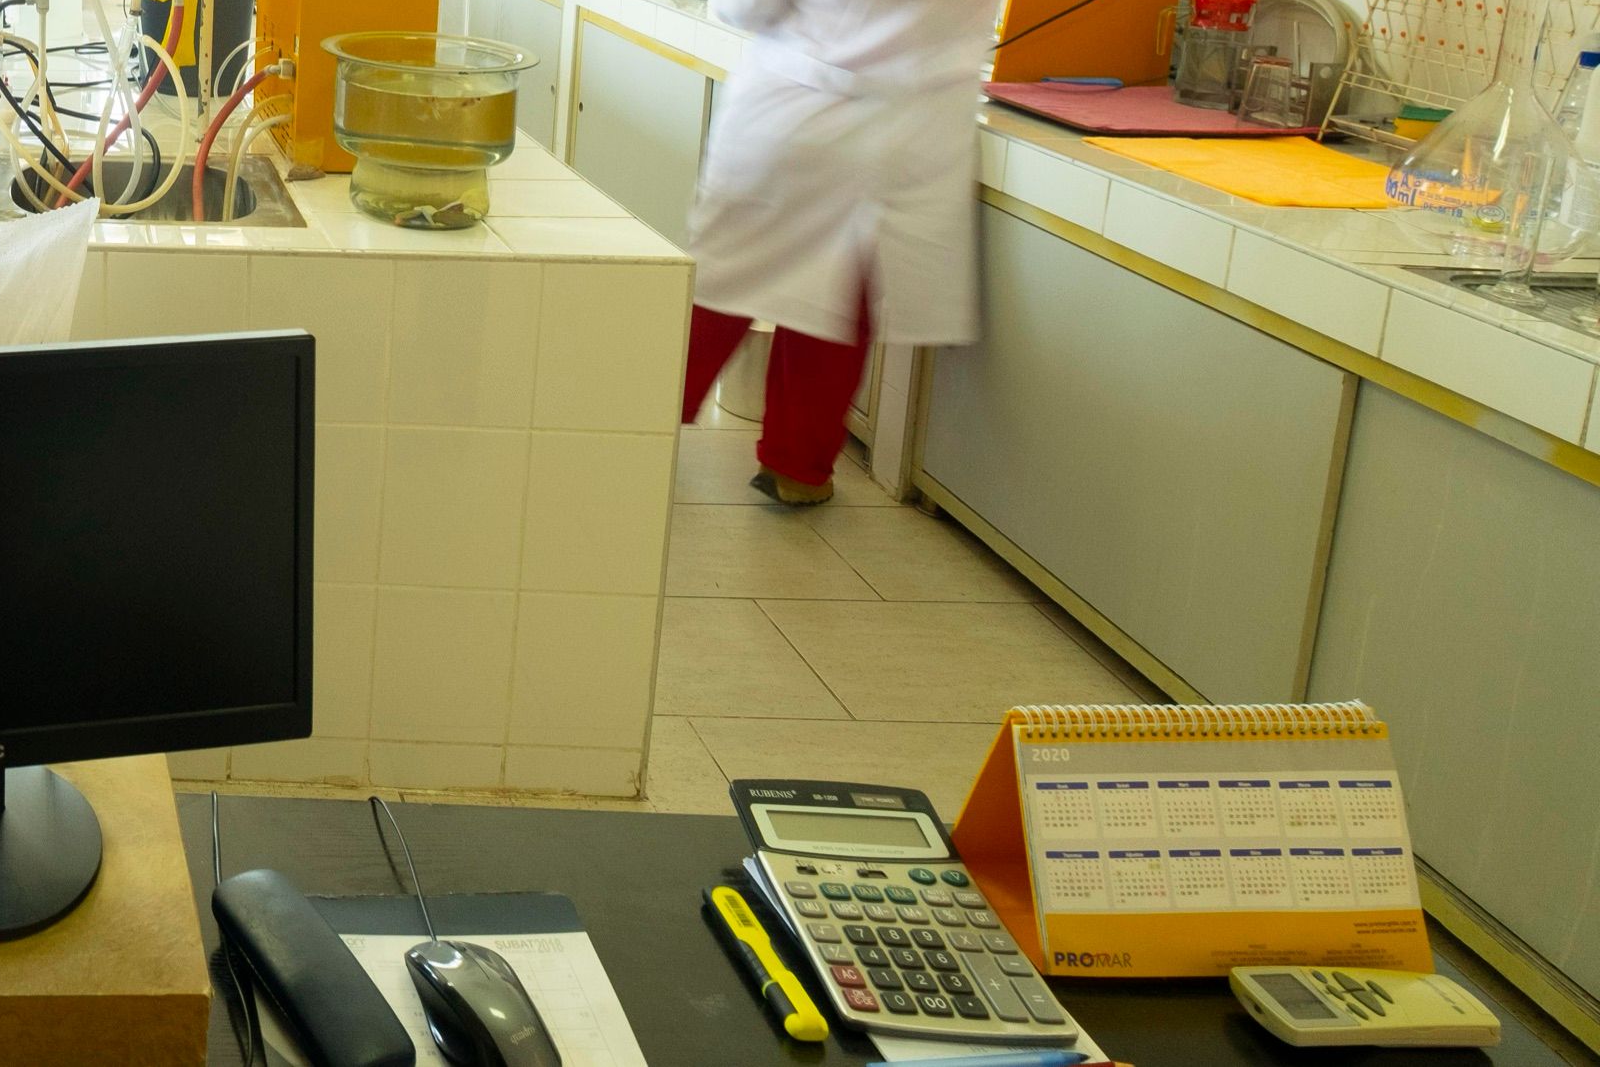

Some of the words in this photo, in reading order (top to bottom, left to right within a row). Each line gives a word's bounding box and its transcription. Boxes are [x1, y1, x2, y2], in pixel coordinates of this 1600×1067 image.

[1031, 748, 1070, 762] 2020
[974, 912, 990, 923] GT
[855, 928, 865, 938] 7
[889, 929, 900, 940] 8
[921, 931, 933, 942] 9
[869, 950, 879, 961] 4
[902, 951, 914, 962] 5
[936, 952, 948, 964] 6
[841, 969, 858, 981] AC
[917, 974, 929, 985] 2
[951, 976, 963, 987] 3
[895, 995, 906, 1007] 0
[924, 997, 947, 1009] 00
